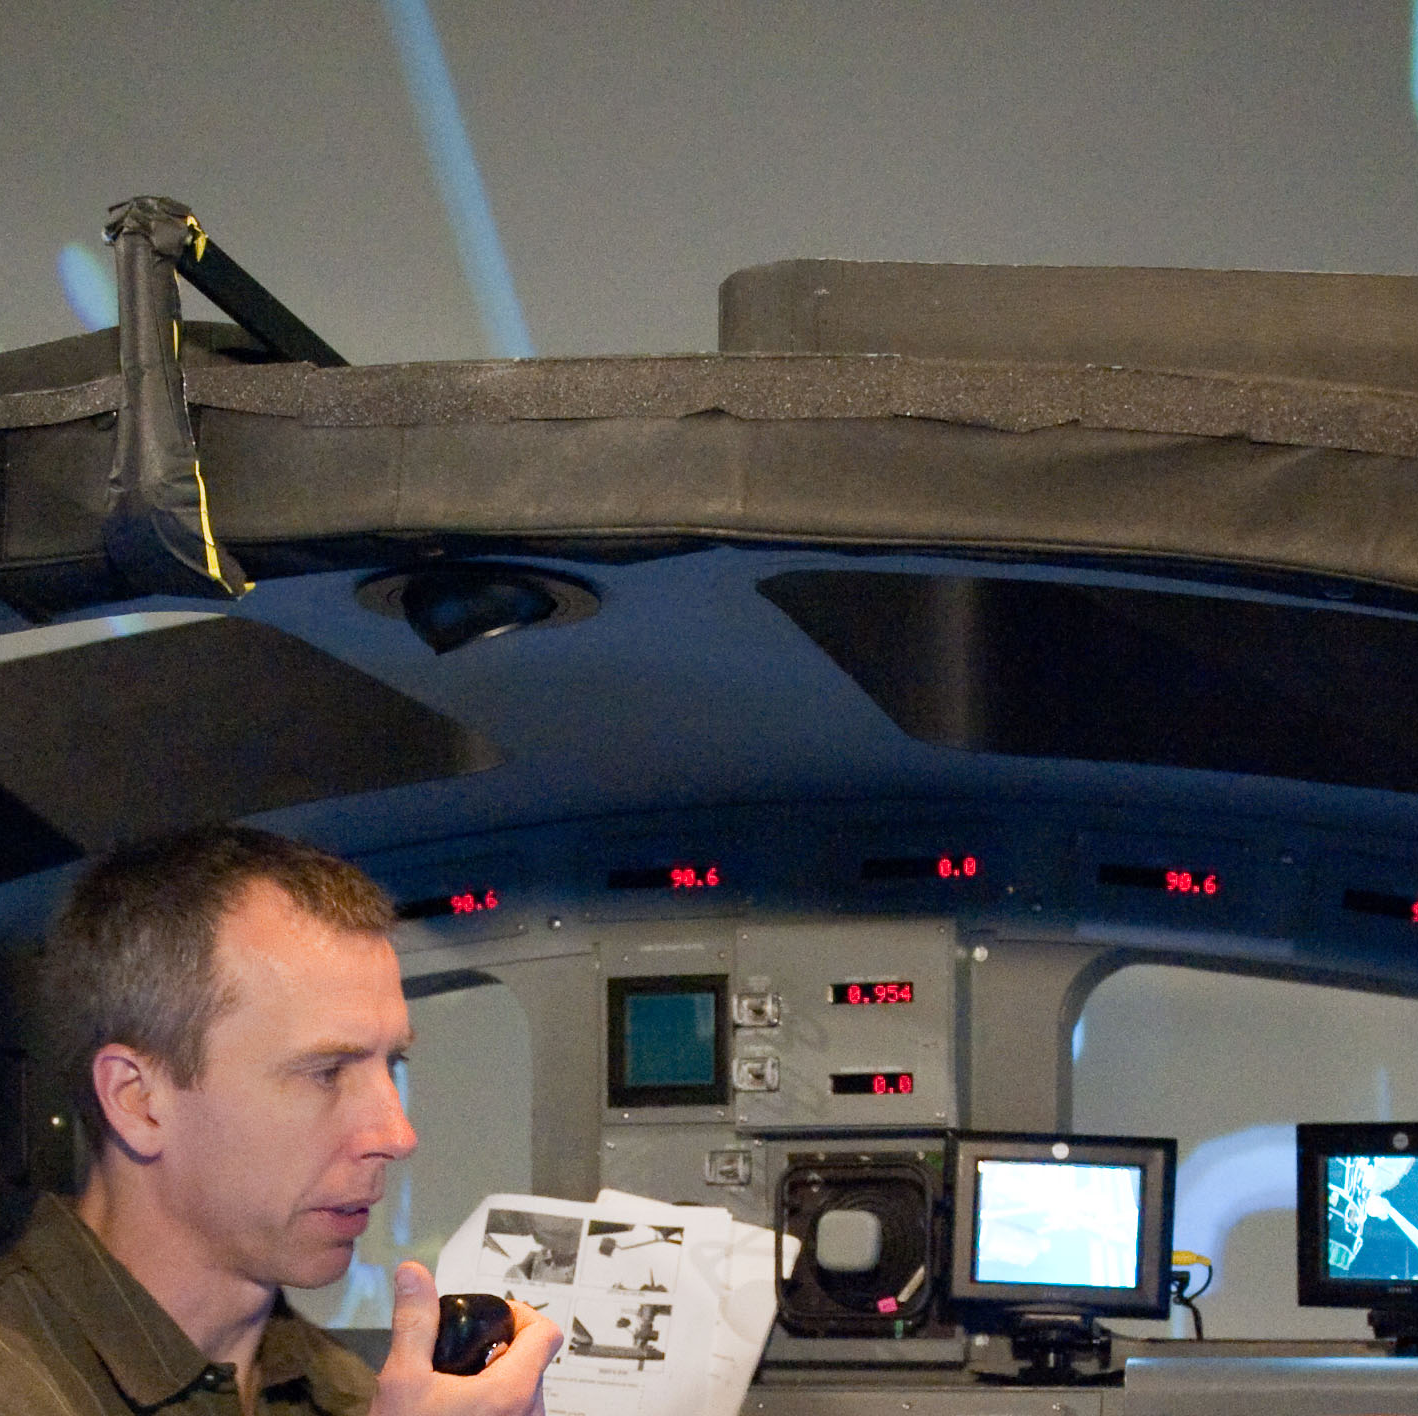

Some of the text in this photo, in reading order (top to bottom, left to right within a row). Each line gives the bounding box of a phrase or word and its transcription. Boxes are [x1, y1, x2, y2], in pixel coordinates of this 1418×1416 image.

[670, 867, 720, 889] 90.6
[937, 856, 977, 878] 0.0
[1165, 870, 1218, 895] 90.6
[450, 890, 498, 913] 90.6
[846, 983, 913, 1005] 0.954
[872, 1074, 913, 1095] 0.0
